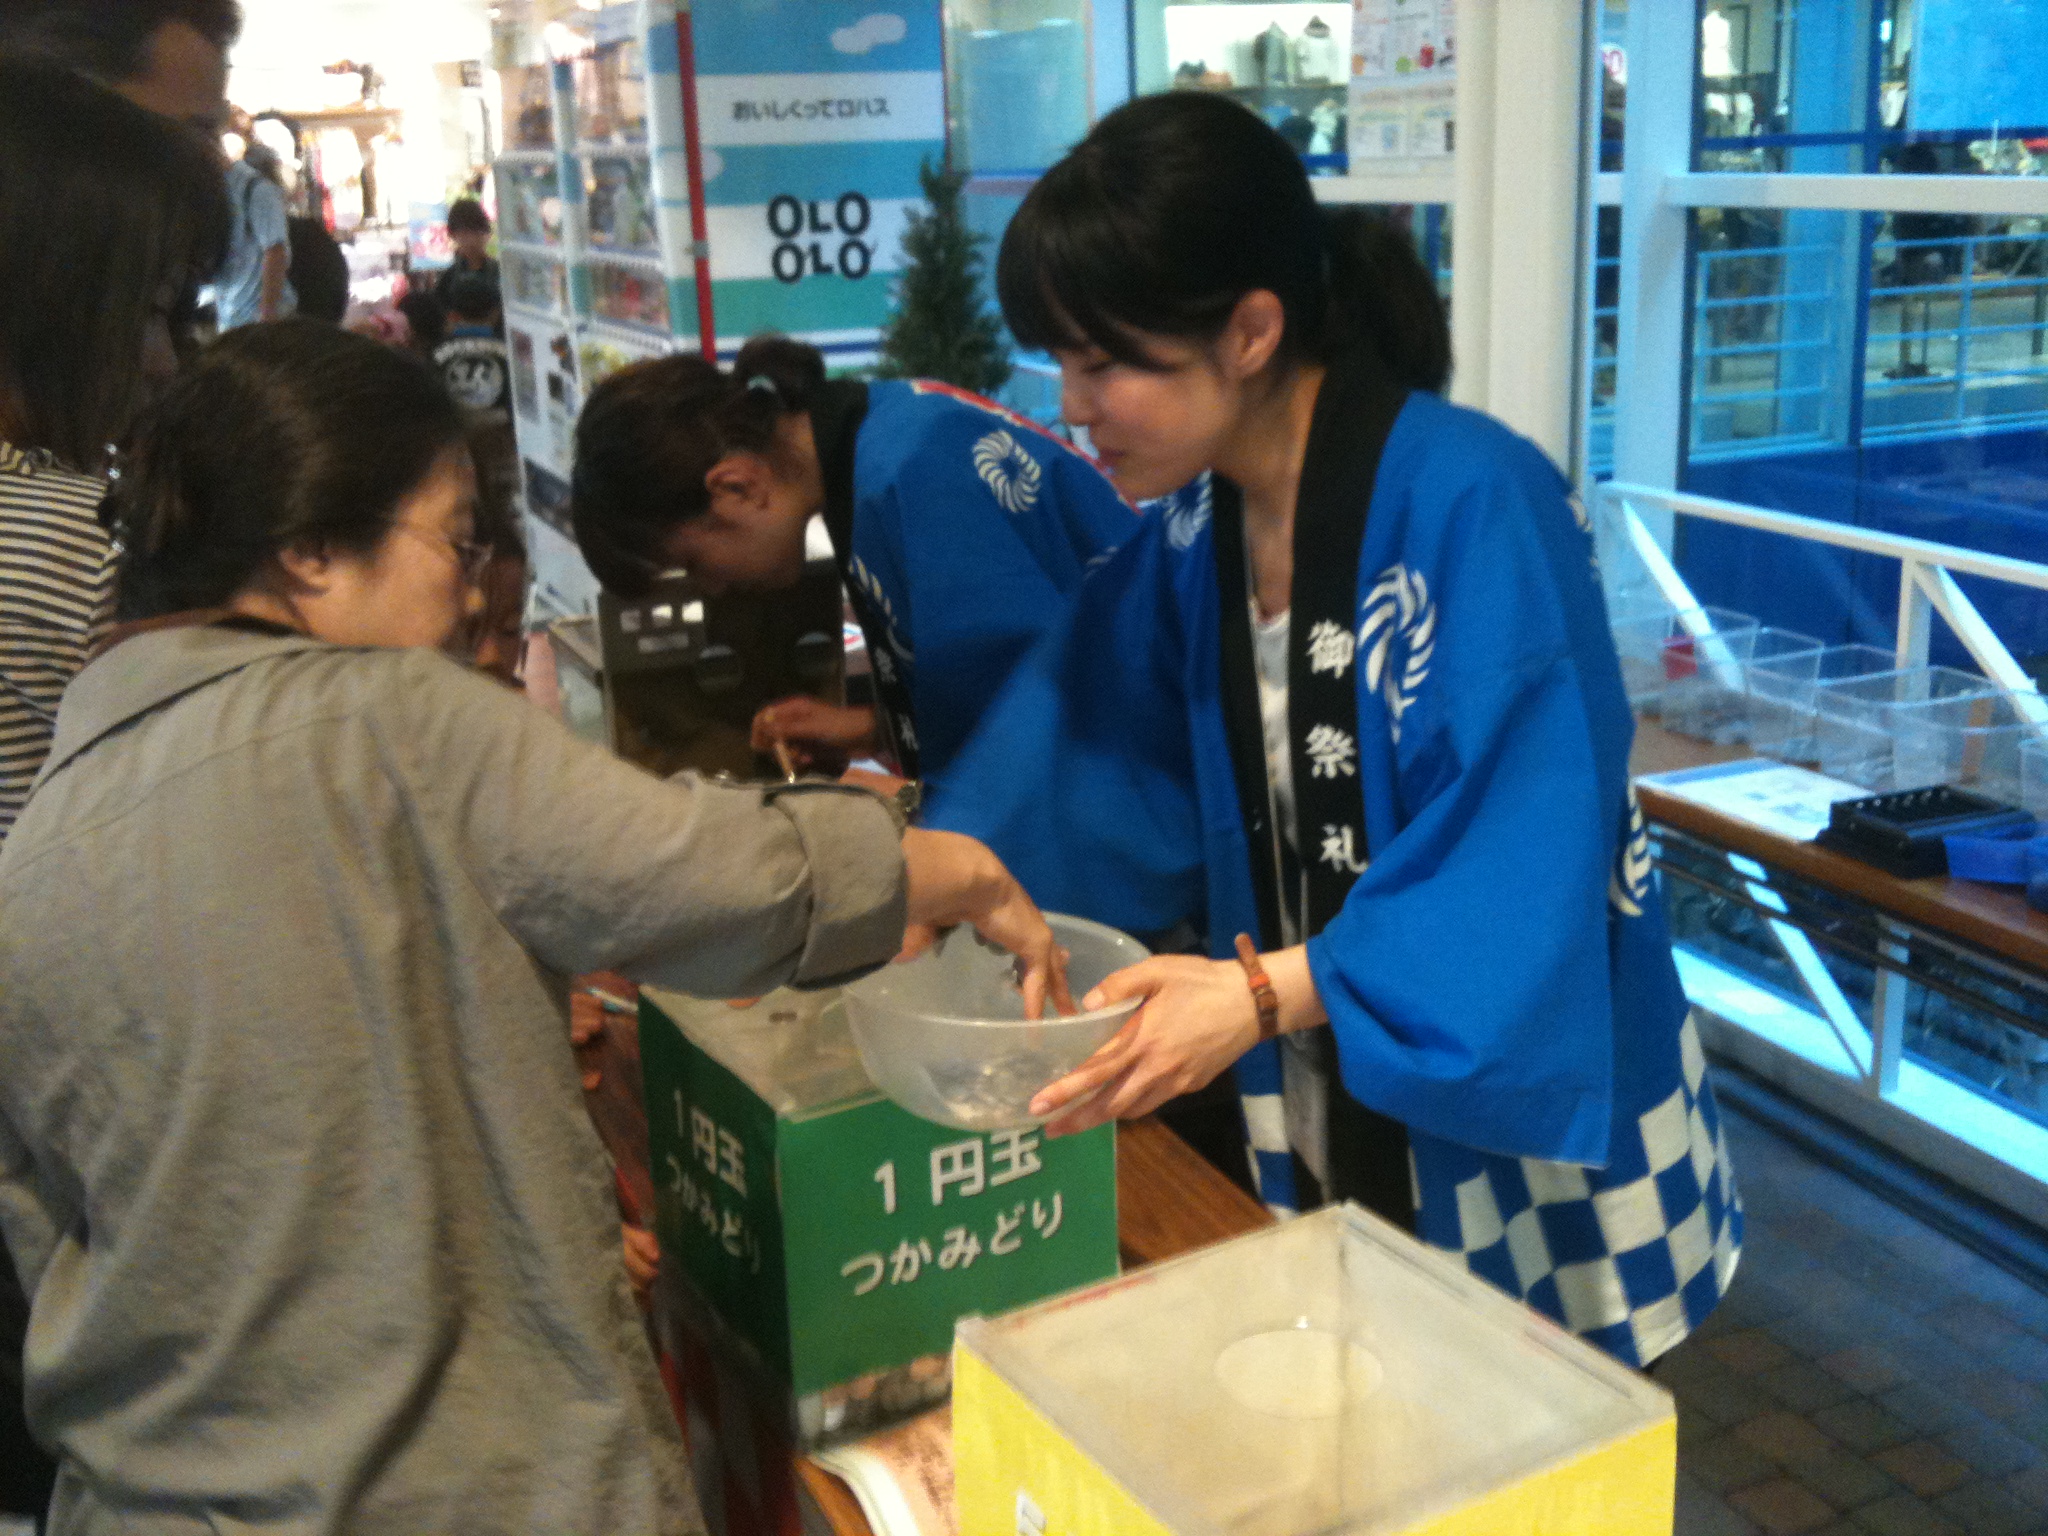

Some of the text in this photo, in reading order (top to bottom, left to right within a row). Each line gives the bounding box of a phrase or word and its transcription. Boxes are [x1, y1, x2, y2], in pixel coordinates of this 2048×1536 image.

[767, 191, 871, 239] OLO
[840, 1190, 1064, 1297] つかみどり
